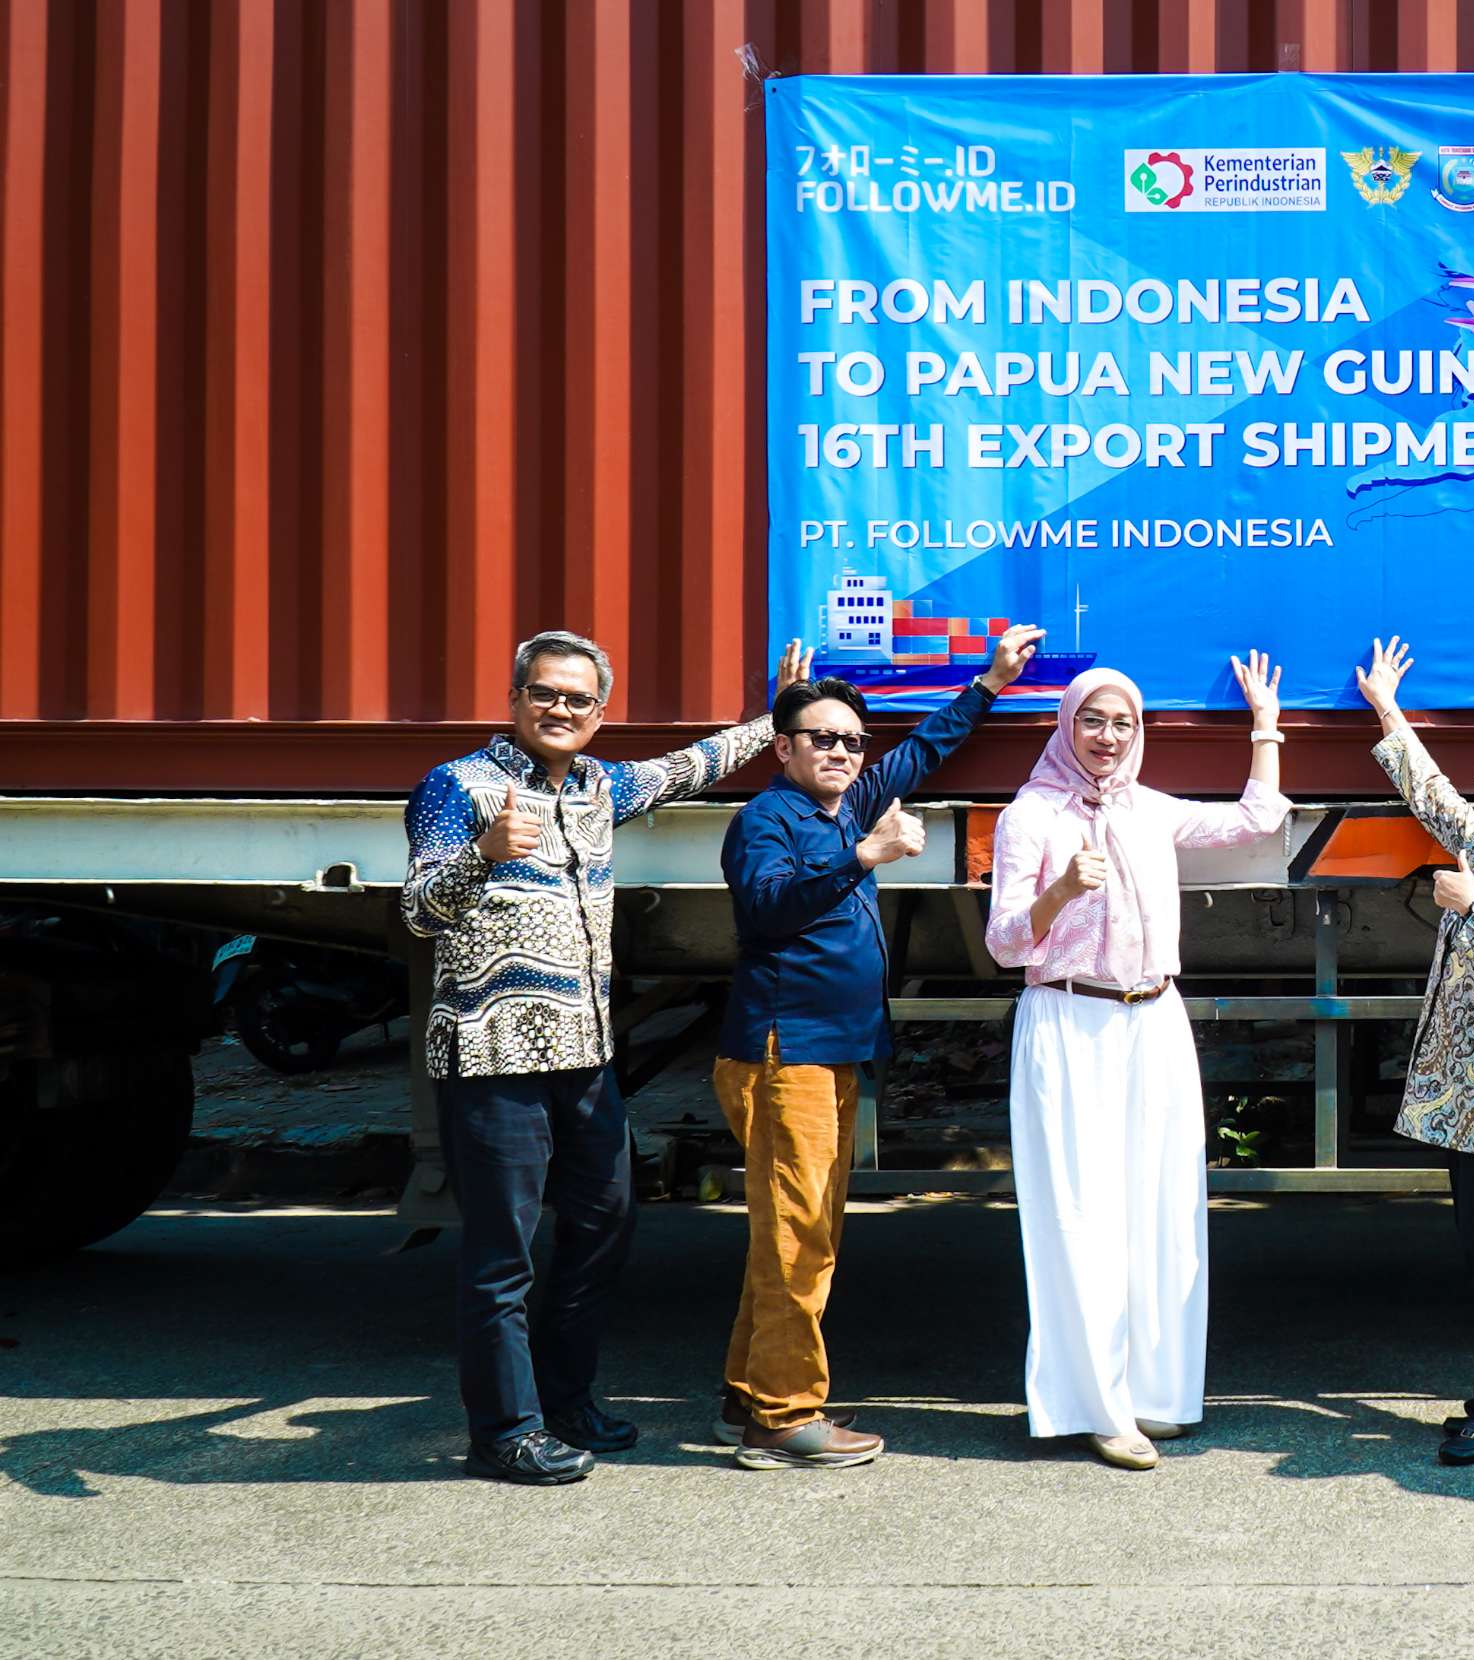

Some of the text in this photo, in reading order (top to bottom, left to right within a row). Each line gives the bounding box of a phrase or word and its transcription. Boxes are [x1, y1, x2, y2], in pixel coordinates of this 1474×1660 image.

[1204, 153, 1316, 171] Kementerian
[796, 180, 1076, 213] FOLLOWME.ID
[1204, 174, 1321, 192] Perindustrian
[1204, 196, 1320, 207] REPUBLIK INDONESIA
[800, 278, 1370, 324] FROM INDONESIA
[798, 351, 886, 396] TO
[906, 350, 1130, 396] PAPUA
[1150, 350, 1303, 395] NEW
[798, 424, 944, 469] 16TH
[968, 423, 1225, 468] EXPORT
[800, 518, 1333, 549] PT. FOLLOWME INDONESIA
